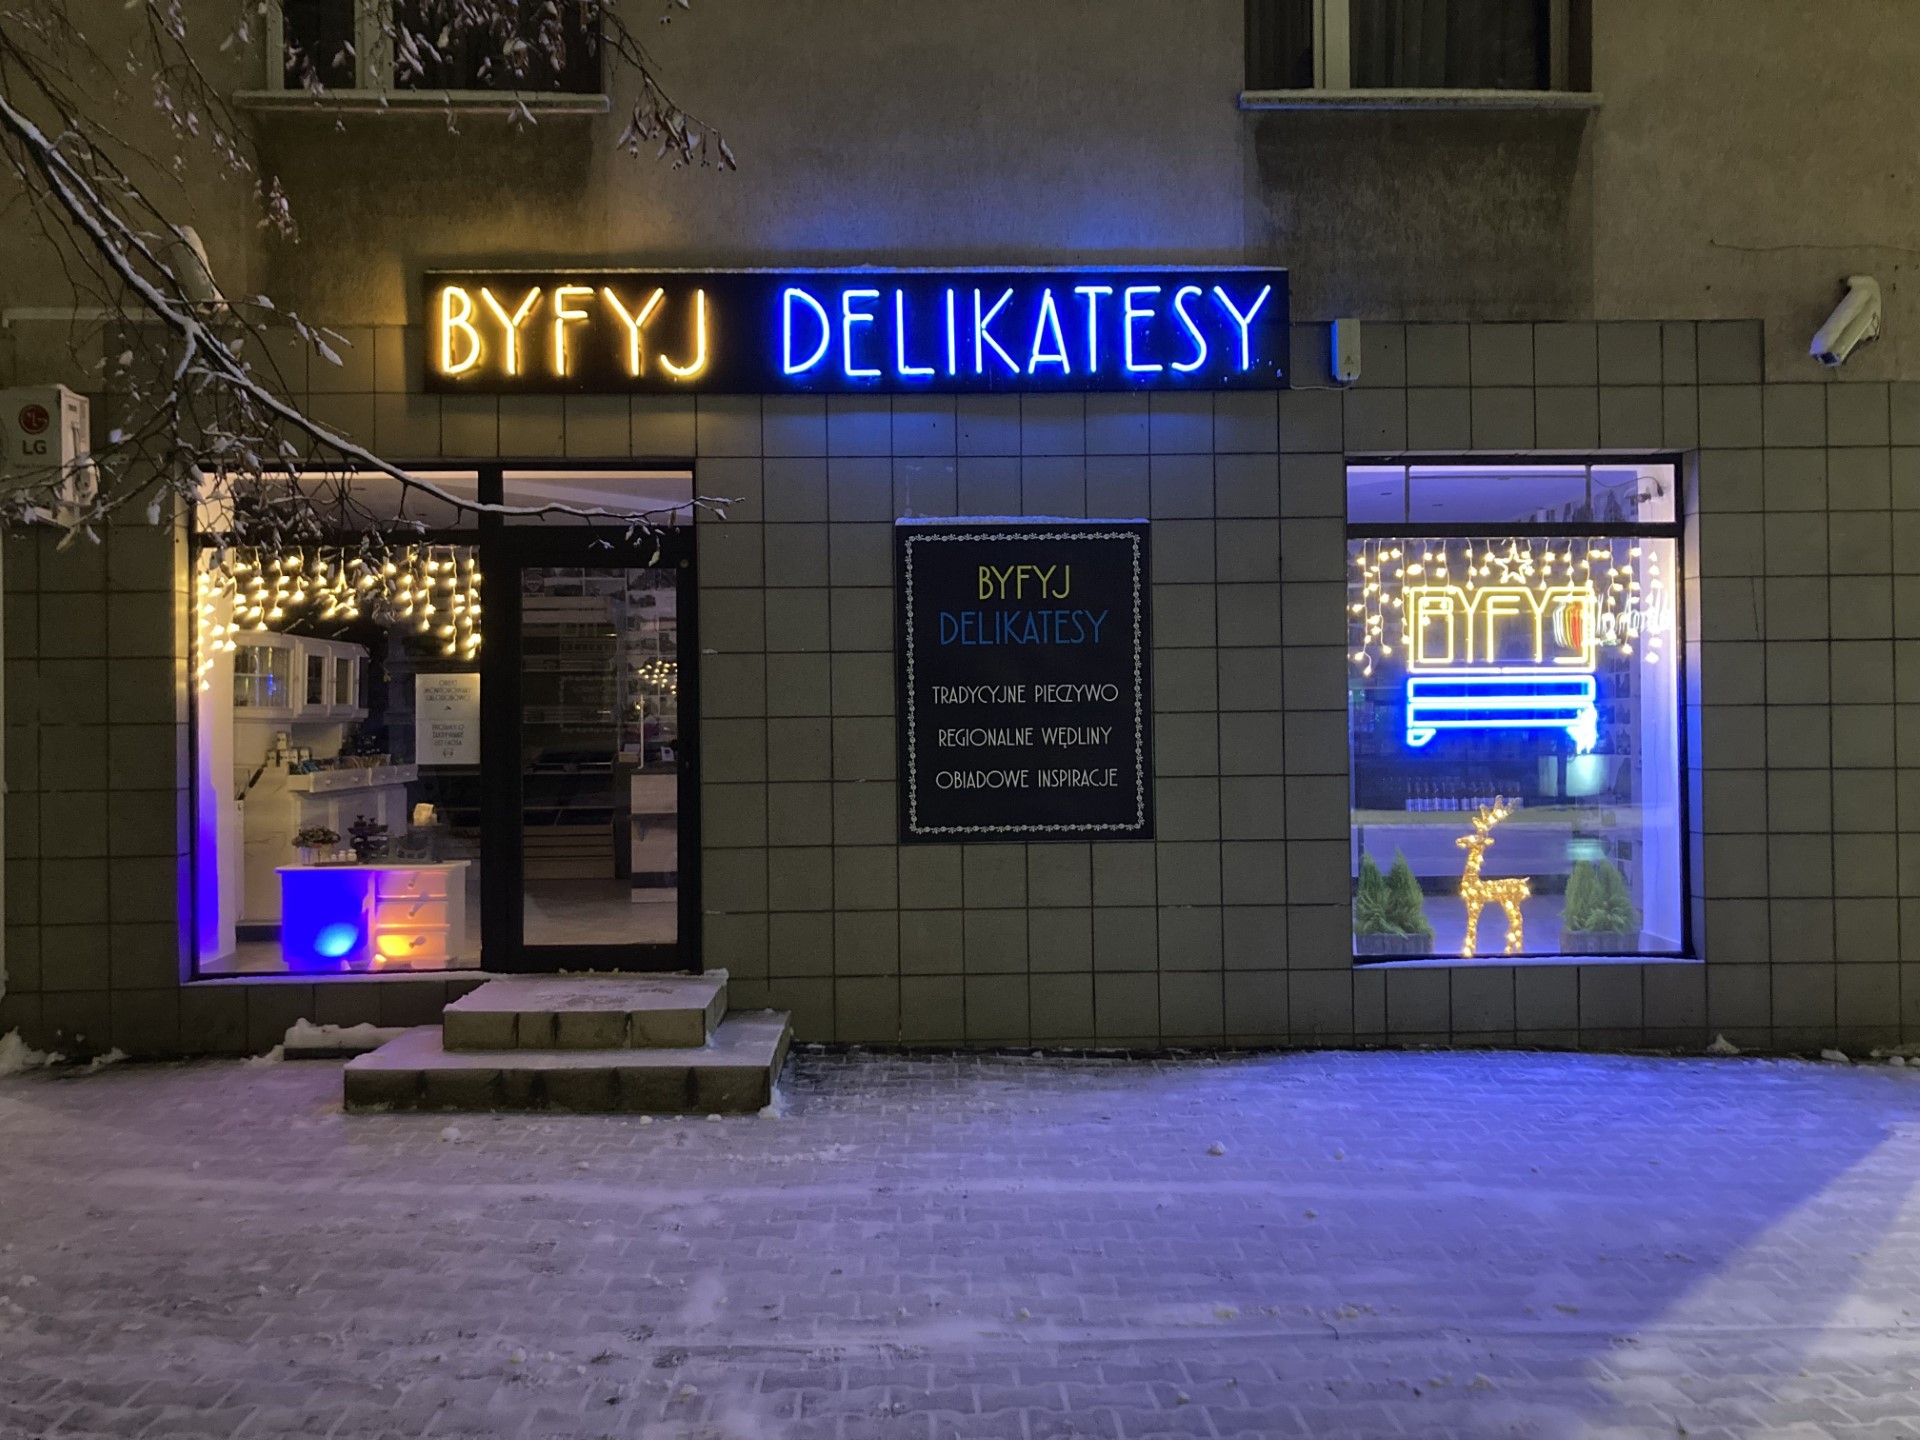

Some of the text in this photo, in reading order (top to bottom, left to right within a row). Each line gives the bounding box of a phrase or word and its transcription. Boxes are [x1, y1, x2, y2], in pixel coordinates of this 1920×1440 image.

[439, 284, 1272, 377] BYFYJ DELIKATESY
[22, 440, 47, 456] LG
[979, 565, 1070, 600] BYFYJ
[940, 610, 1108, 646] DELIKATESY
[932, 684, 1119, 704] TRADYCYJNE PIECZYWO
[938, 726, 1112, 749] REGIONALNE WĘDLINY
[935, 768, 1118, 789] OBIADOWE INSPIRACJE
